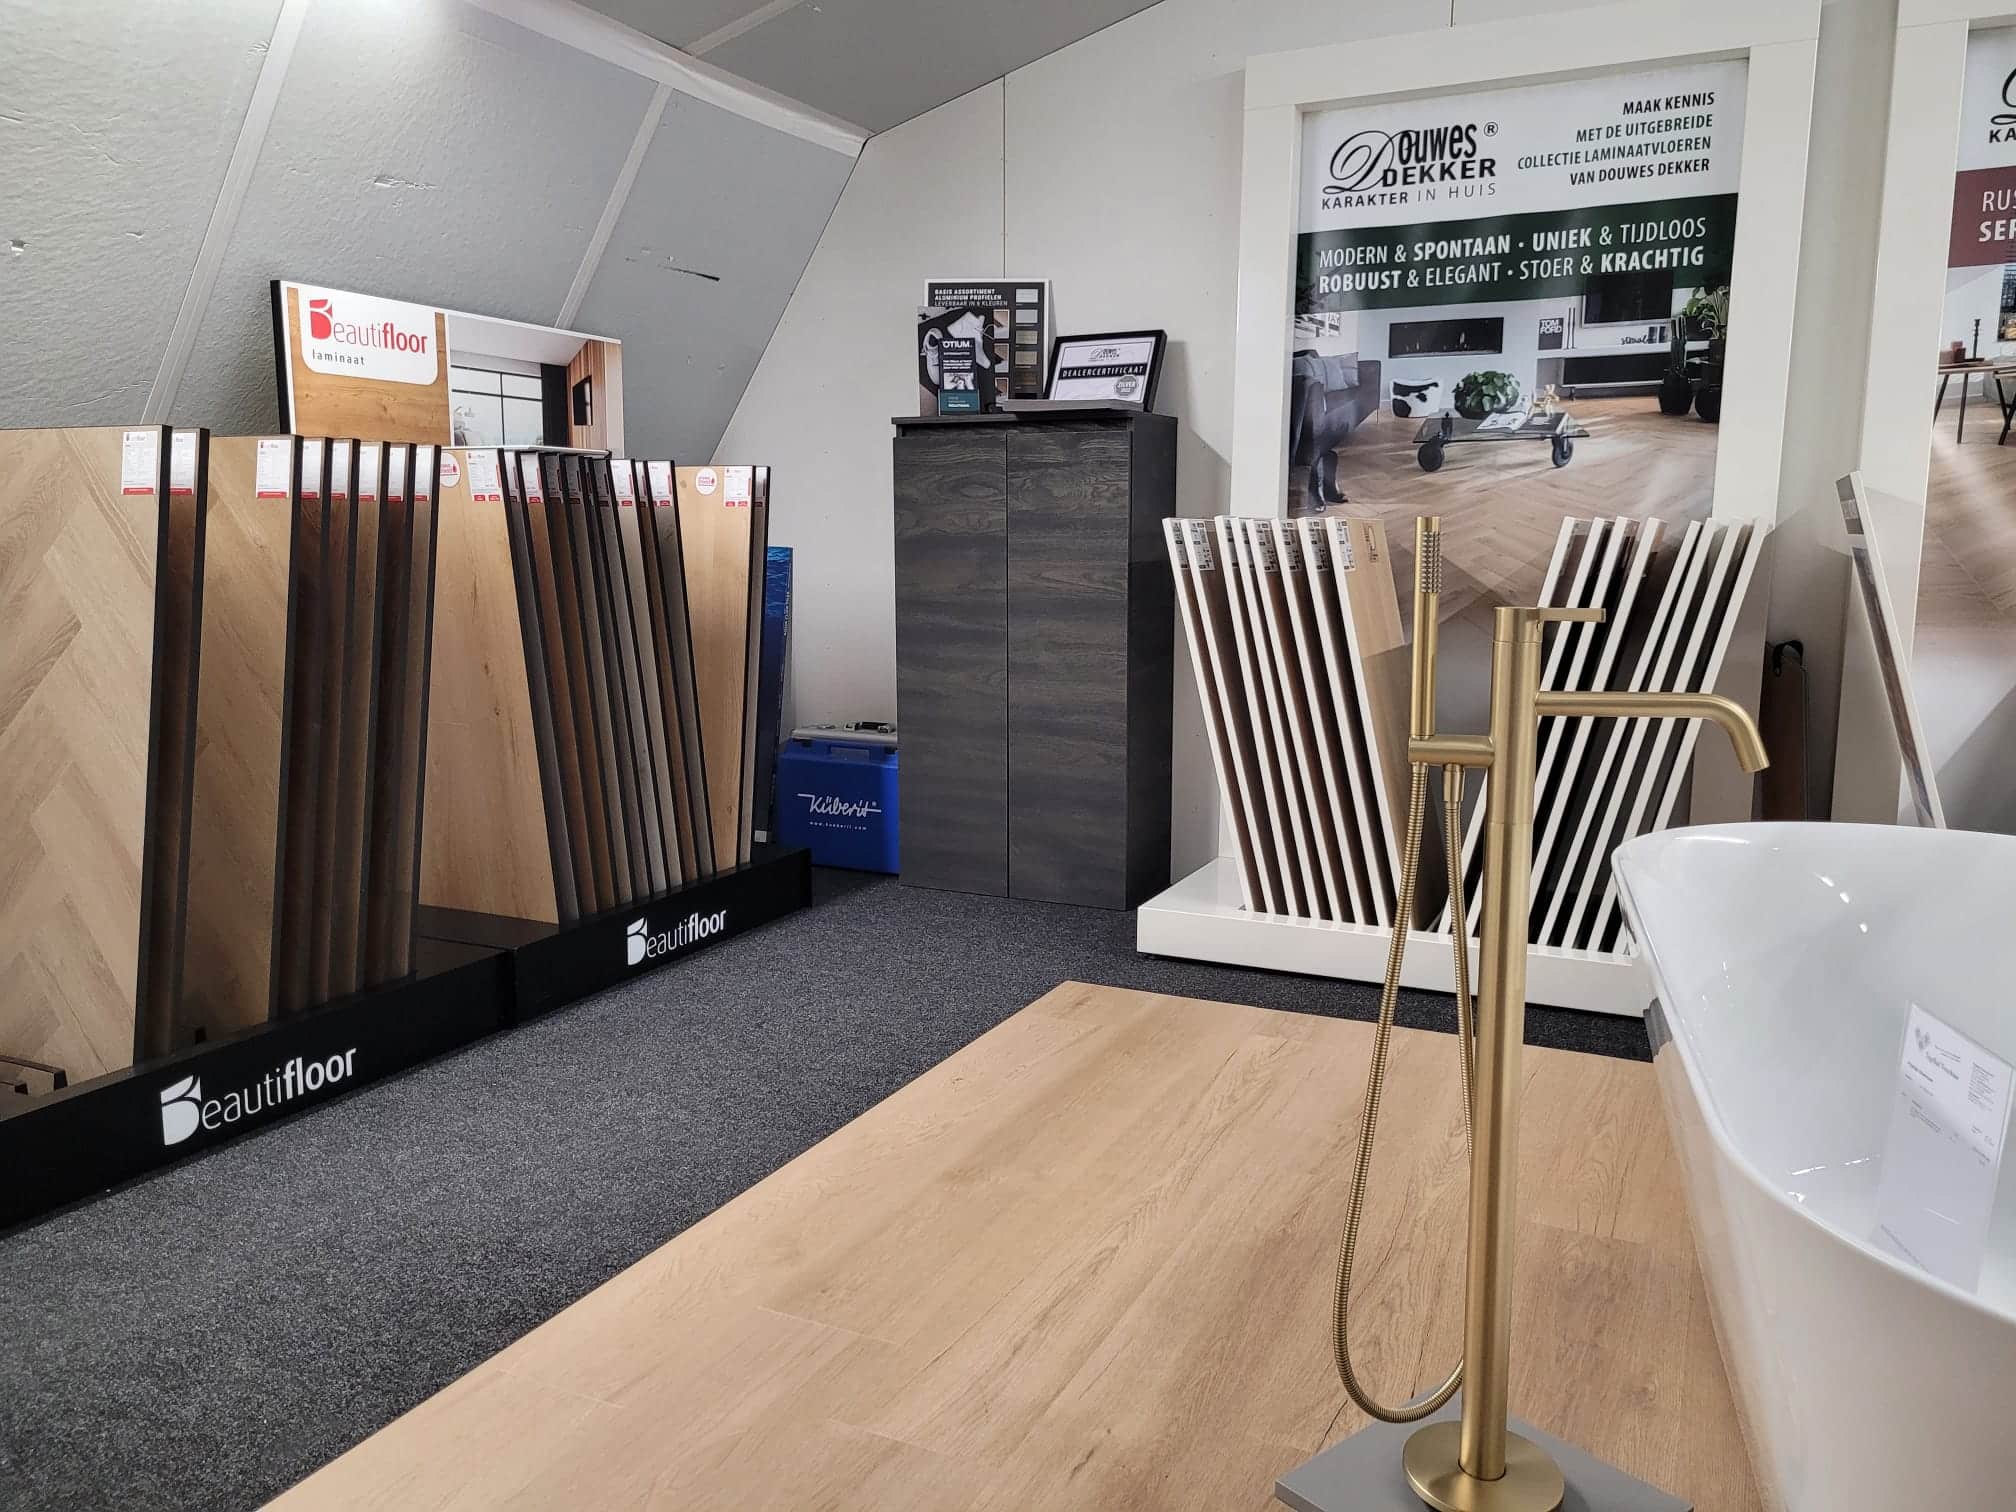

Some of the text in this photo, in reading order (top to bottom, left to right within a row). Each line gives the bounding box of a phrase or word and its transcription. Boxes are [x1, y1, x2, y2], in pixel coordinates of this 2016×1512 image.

[1623, 92, 1715, 115] MAAK KENNIS
[1576, 114, 1713, 143] MET DE UITGEBREIDE
[1518, 136, 1711, 170] COLLECTIE LAMINAATVLOEREN
[1382, 158, 1496, 187] DEKKER
[1570, 158, 1710, 185] VAN DOUWES DEKKER
[1322, 183, 1496, 210] KARAKTER IN HUIS
[1319, 217, 1706, 268] MODERN & SPONTAAN UNIEK & TIJDLOOS
[1319, 246, 1705, 293] ROBUUST & ELEGANT STOER & KRACHTIG
[309, 299, 428, 354] Beautifloor
[312, 349, 366, 366] laminaat
[1062, 366, 1143, 377] DEALERCERTIFICAAT
[627, 908, 727, 966] Beautifloor
[160, 1048, 357, 1146] Beautifloor
